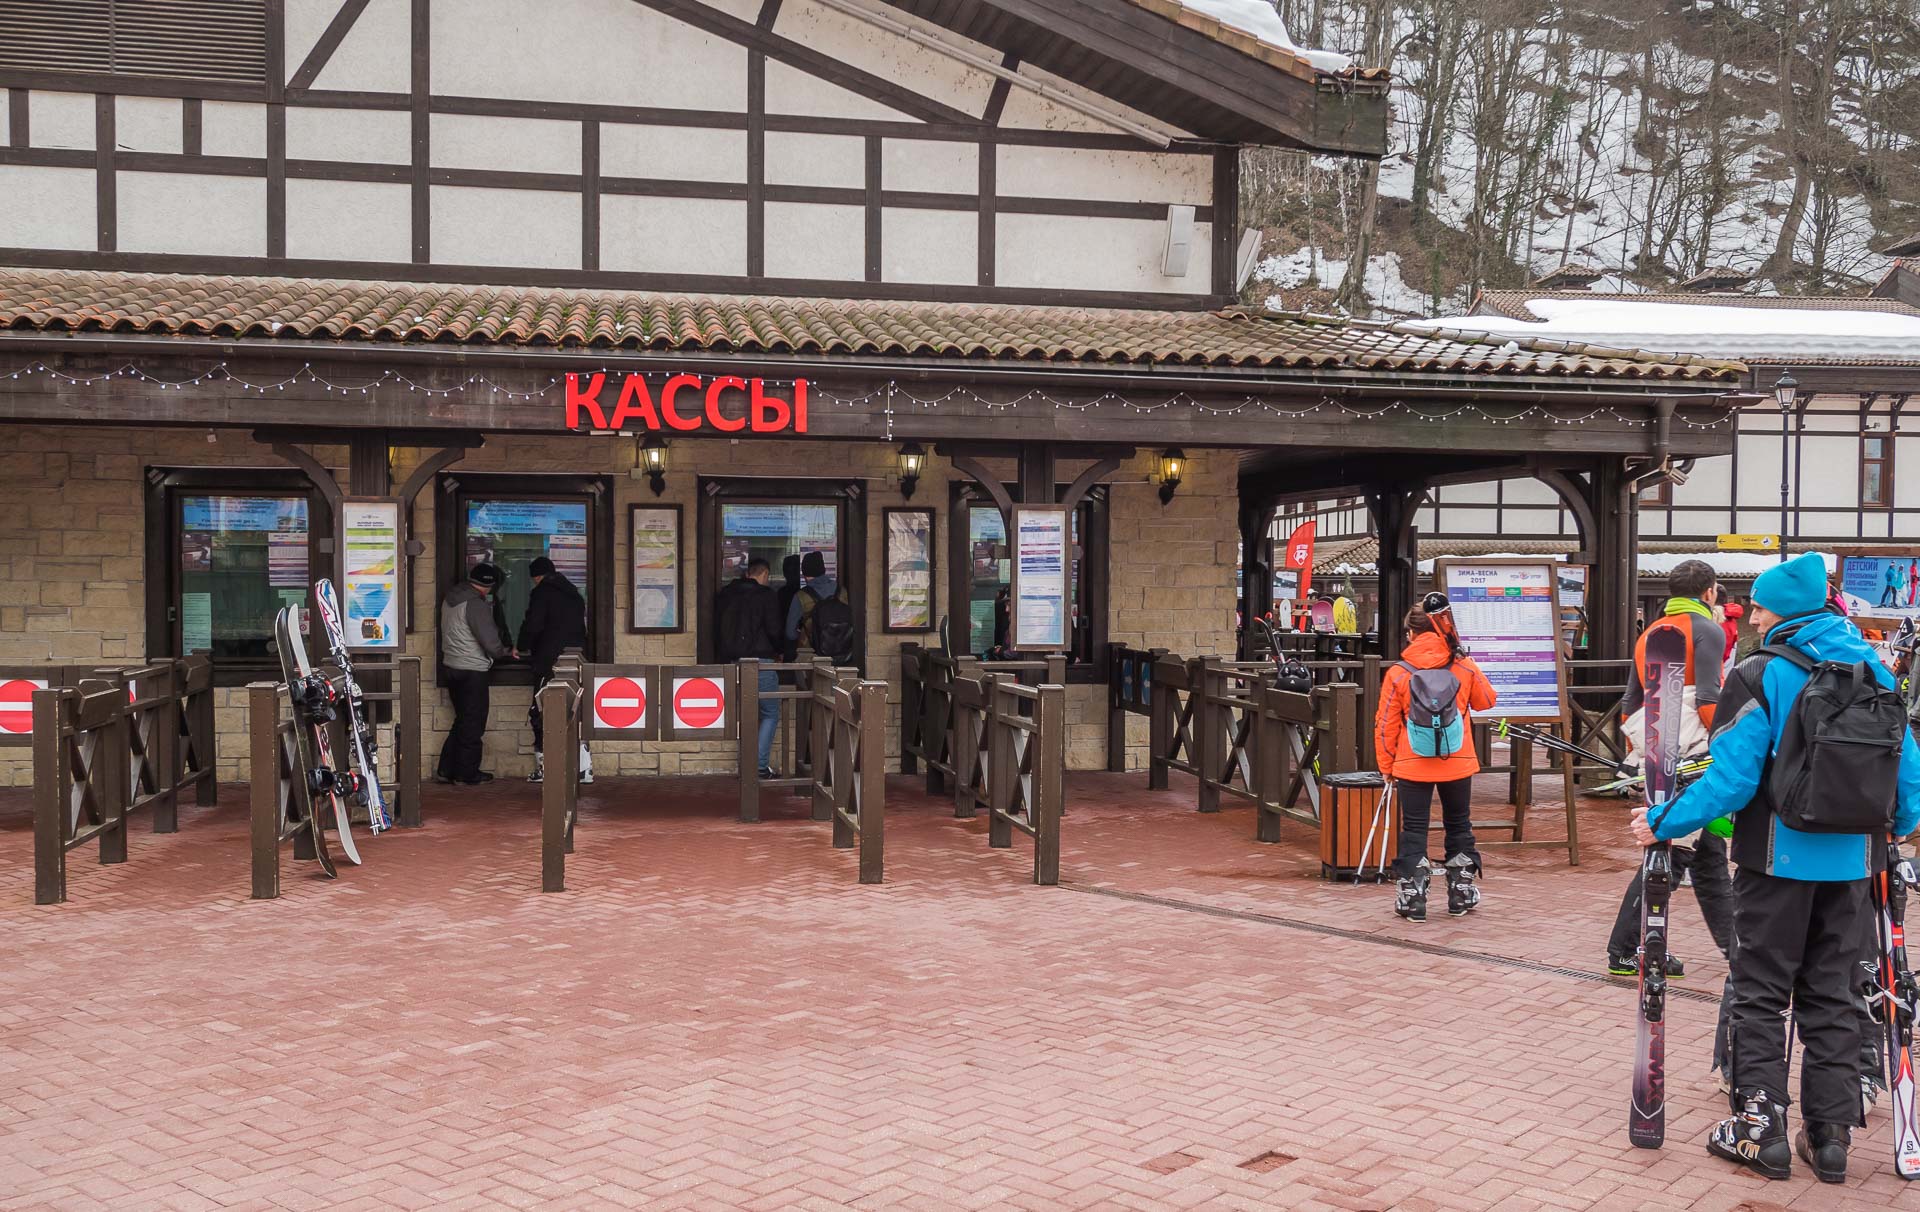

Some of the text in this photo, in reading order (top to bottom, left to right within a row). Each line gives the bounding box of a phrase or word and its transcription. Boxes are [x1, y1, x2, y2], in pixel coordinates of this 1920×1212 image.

[565, 373, 808, 433] КАССЫ
[1846, 561, 1878, 571] ДЕТСКИЙ
[1664, 662, 1686, 777] SALOMON
